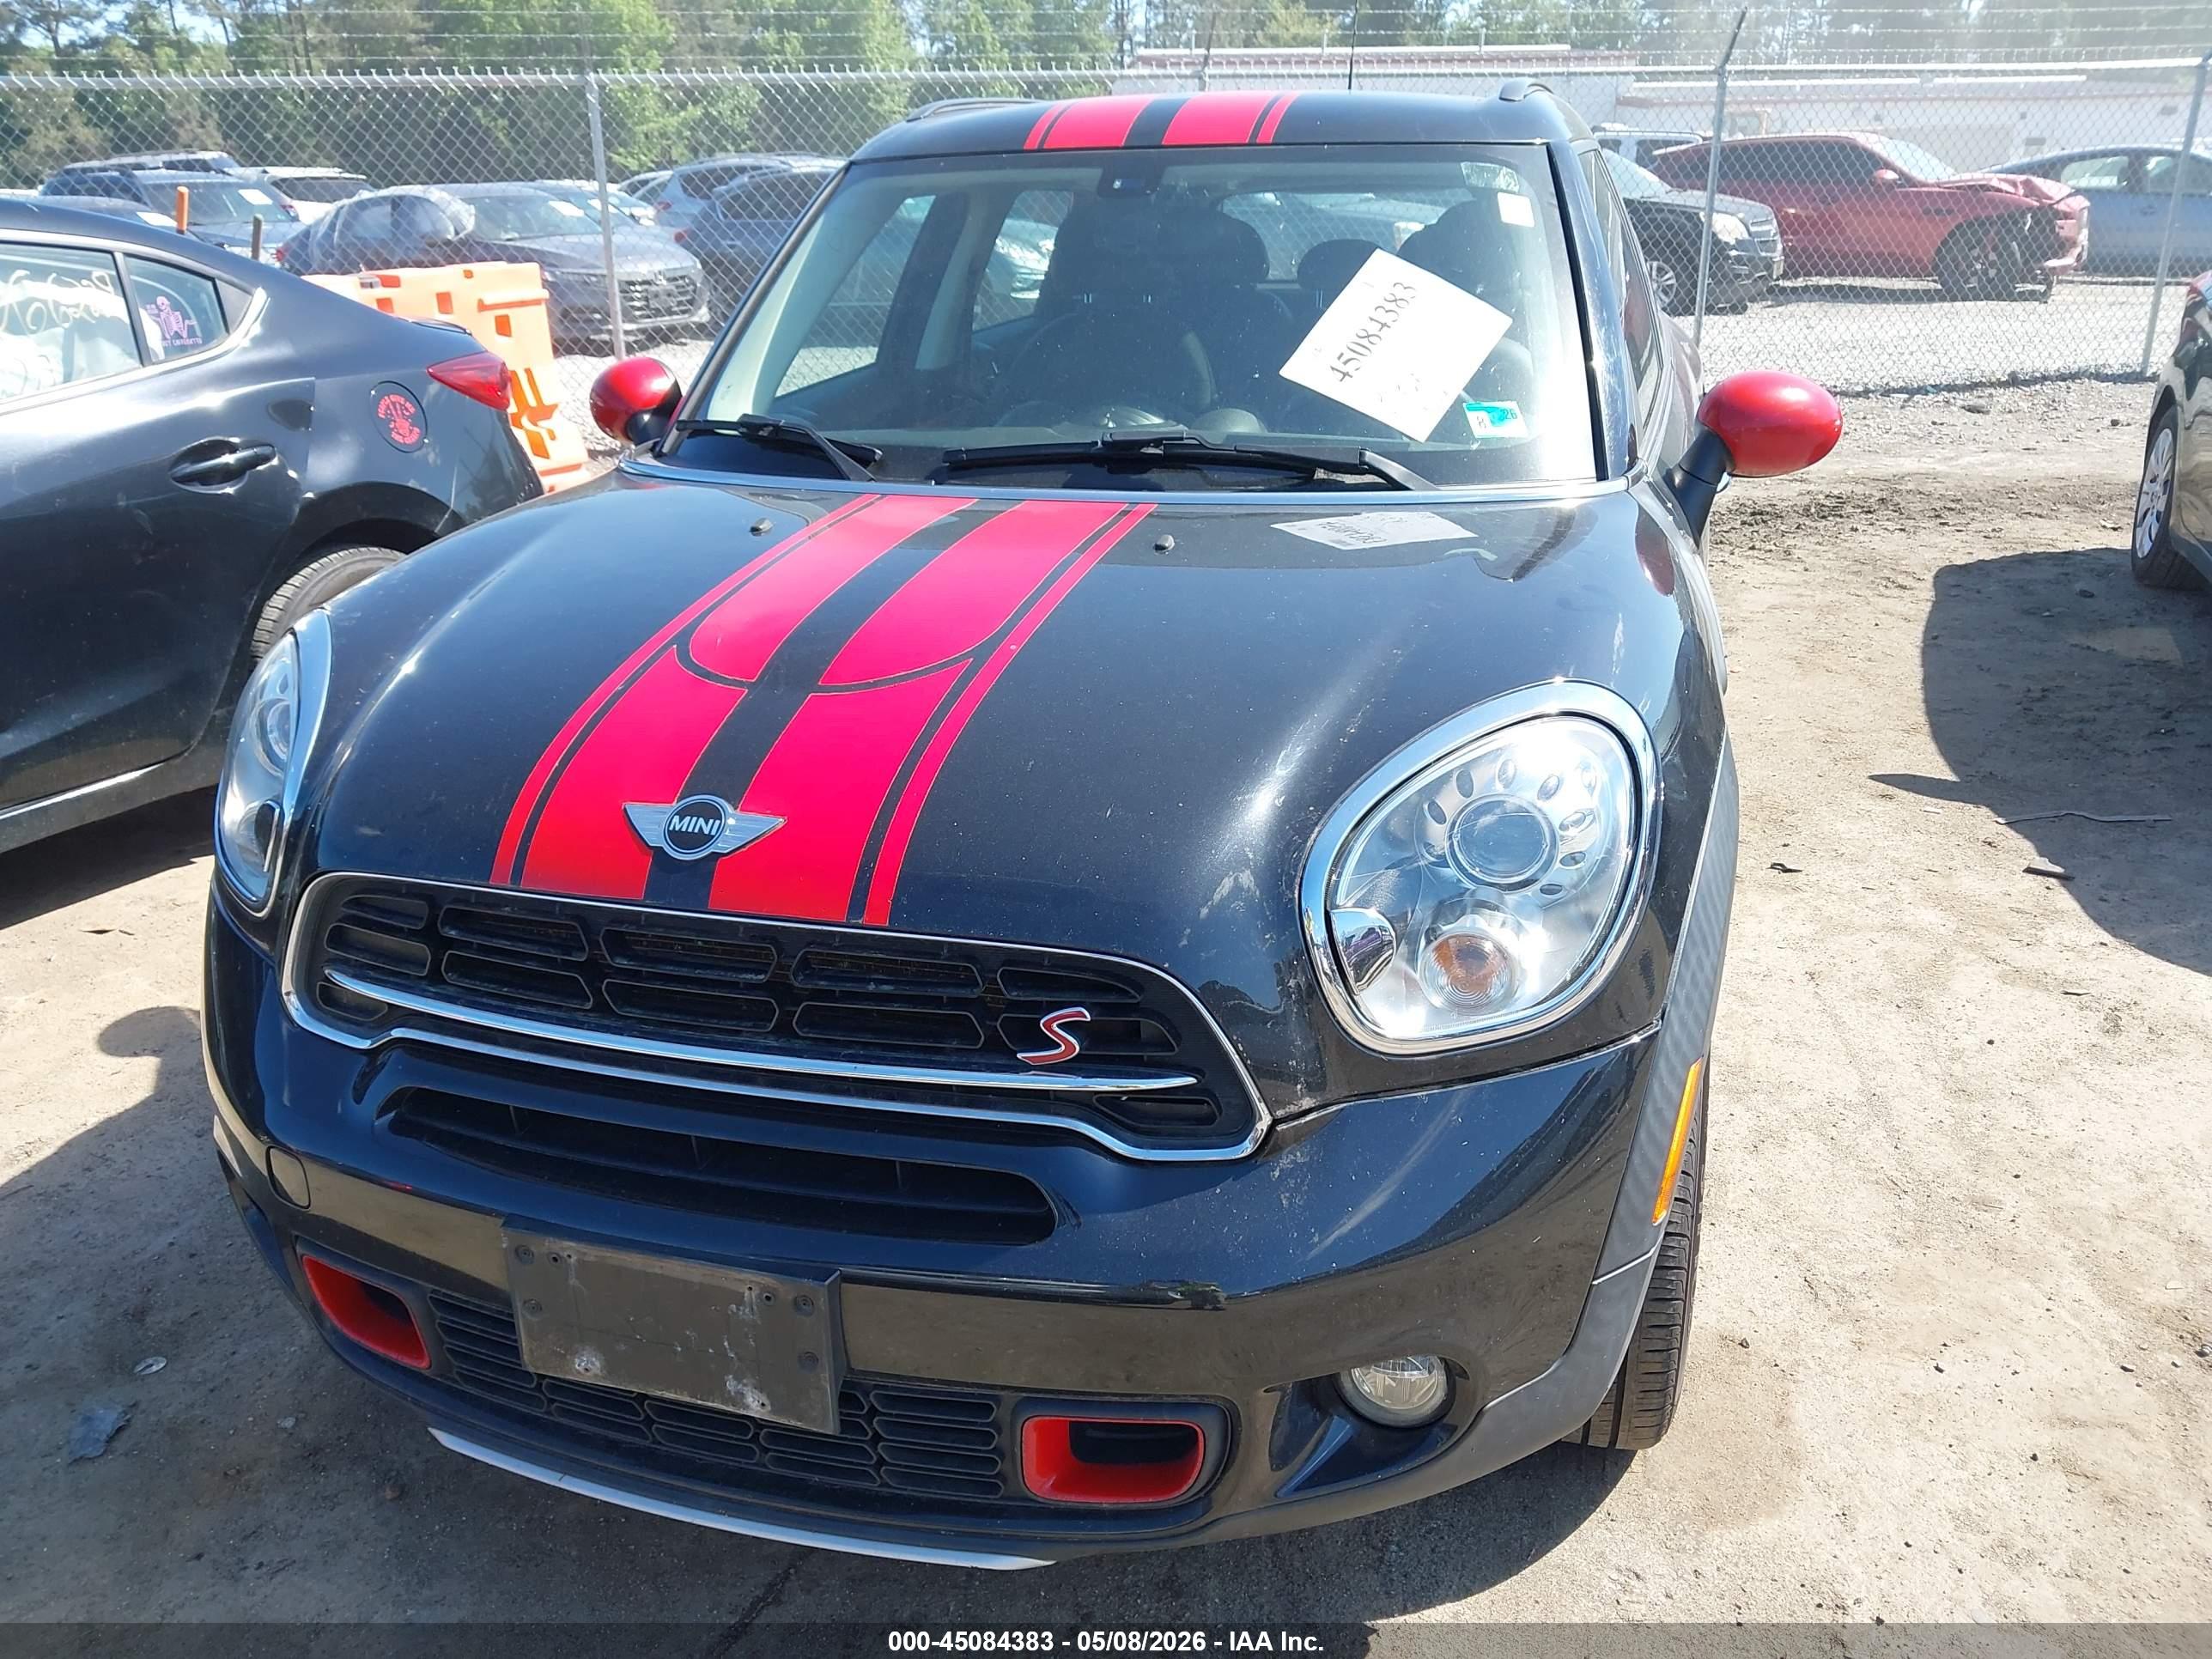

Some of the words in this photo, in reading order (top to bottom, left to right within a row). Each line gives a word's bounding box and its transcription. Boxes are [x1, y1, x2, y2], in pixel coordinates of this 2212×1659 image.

[1329, 281, 1416, 383] 45084383
[669, 815, 721, 836] MINI
[1017, 1006, 1091, 1066] S
